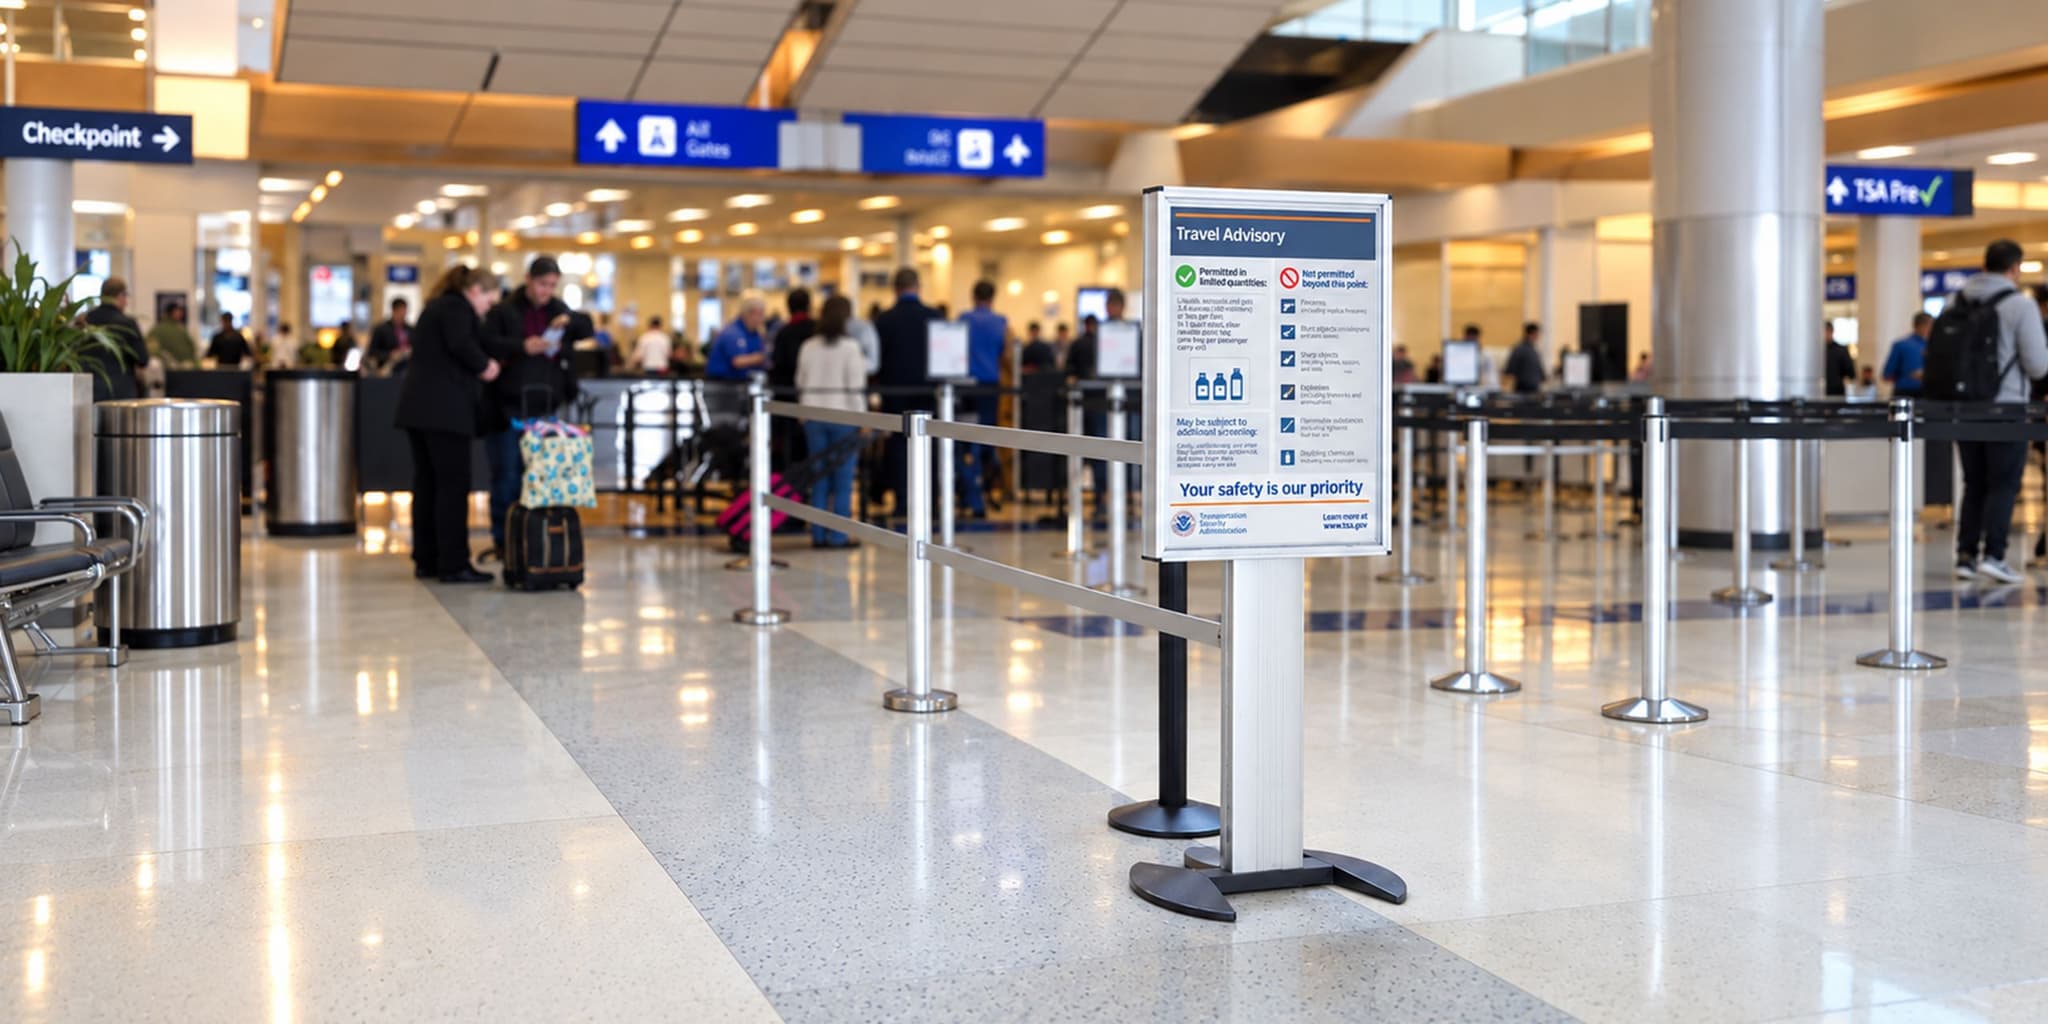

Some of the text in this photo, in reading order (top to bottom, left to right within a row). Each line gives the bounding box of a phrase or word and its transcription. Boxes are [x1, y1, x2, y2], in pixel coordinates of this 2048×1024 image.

[22, 120, 142, 150] Checkpoint
[685, 139, 731, 159] Gates
[1853, 178, 1920, 205] TSA Pre
[1176, 226, 1286, 246] Travel Advisory
[1199, 267, 1247, 276] Permitted in
[1302, 270, 1355, 279] Not permitted
[1199, 277, 1226, 286] limited
[1302, 280, 1368, 289] beyond this point:
[1176, 417, 1248, 428] May be subject to
[1176, 428, 1216, 436] additional
[1180, 479, 1363, 498] Your safety is our priority
[1199, 512, 1247, 520] Transportation
[1322, 513, 1342, 521] Learn
[1343, 513, 1358, 521] more
[1323, 522, 1368, 530] www.tsa.gov
